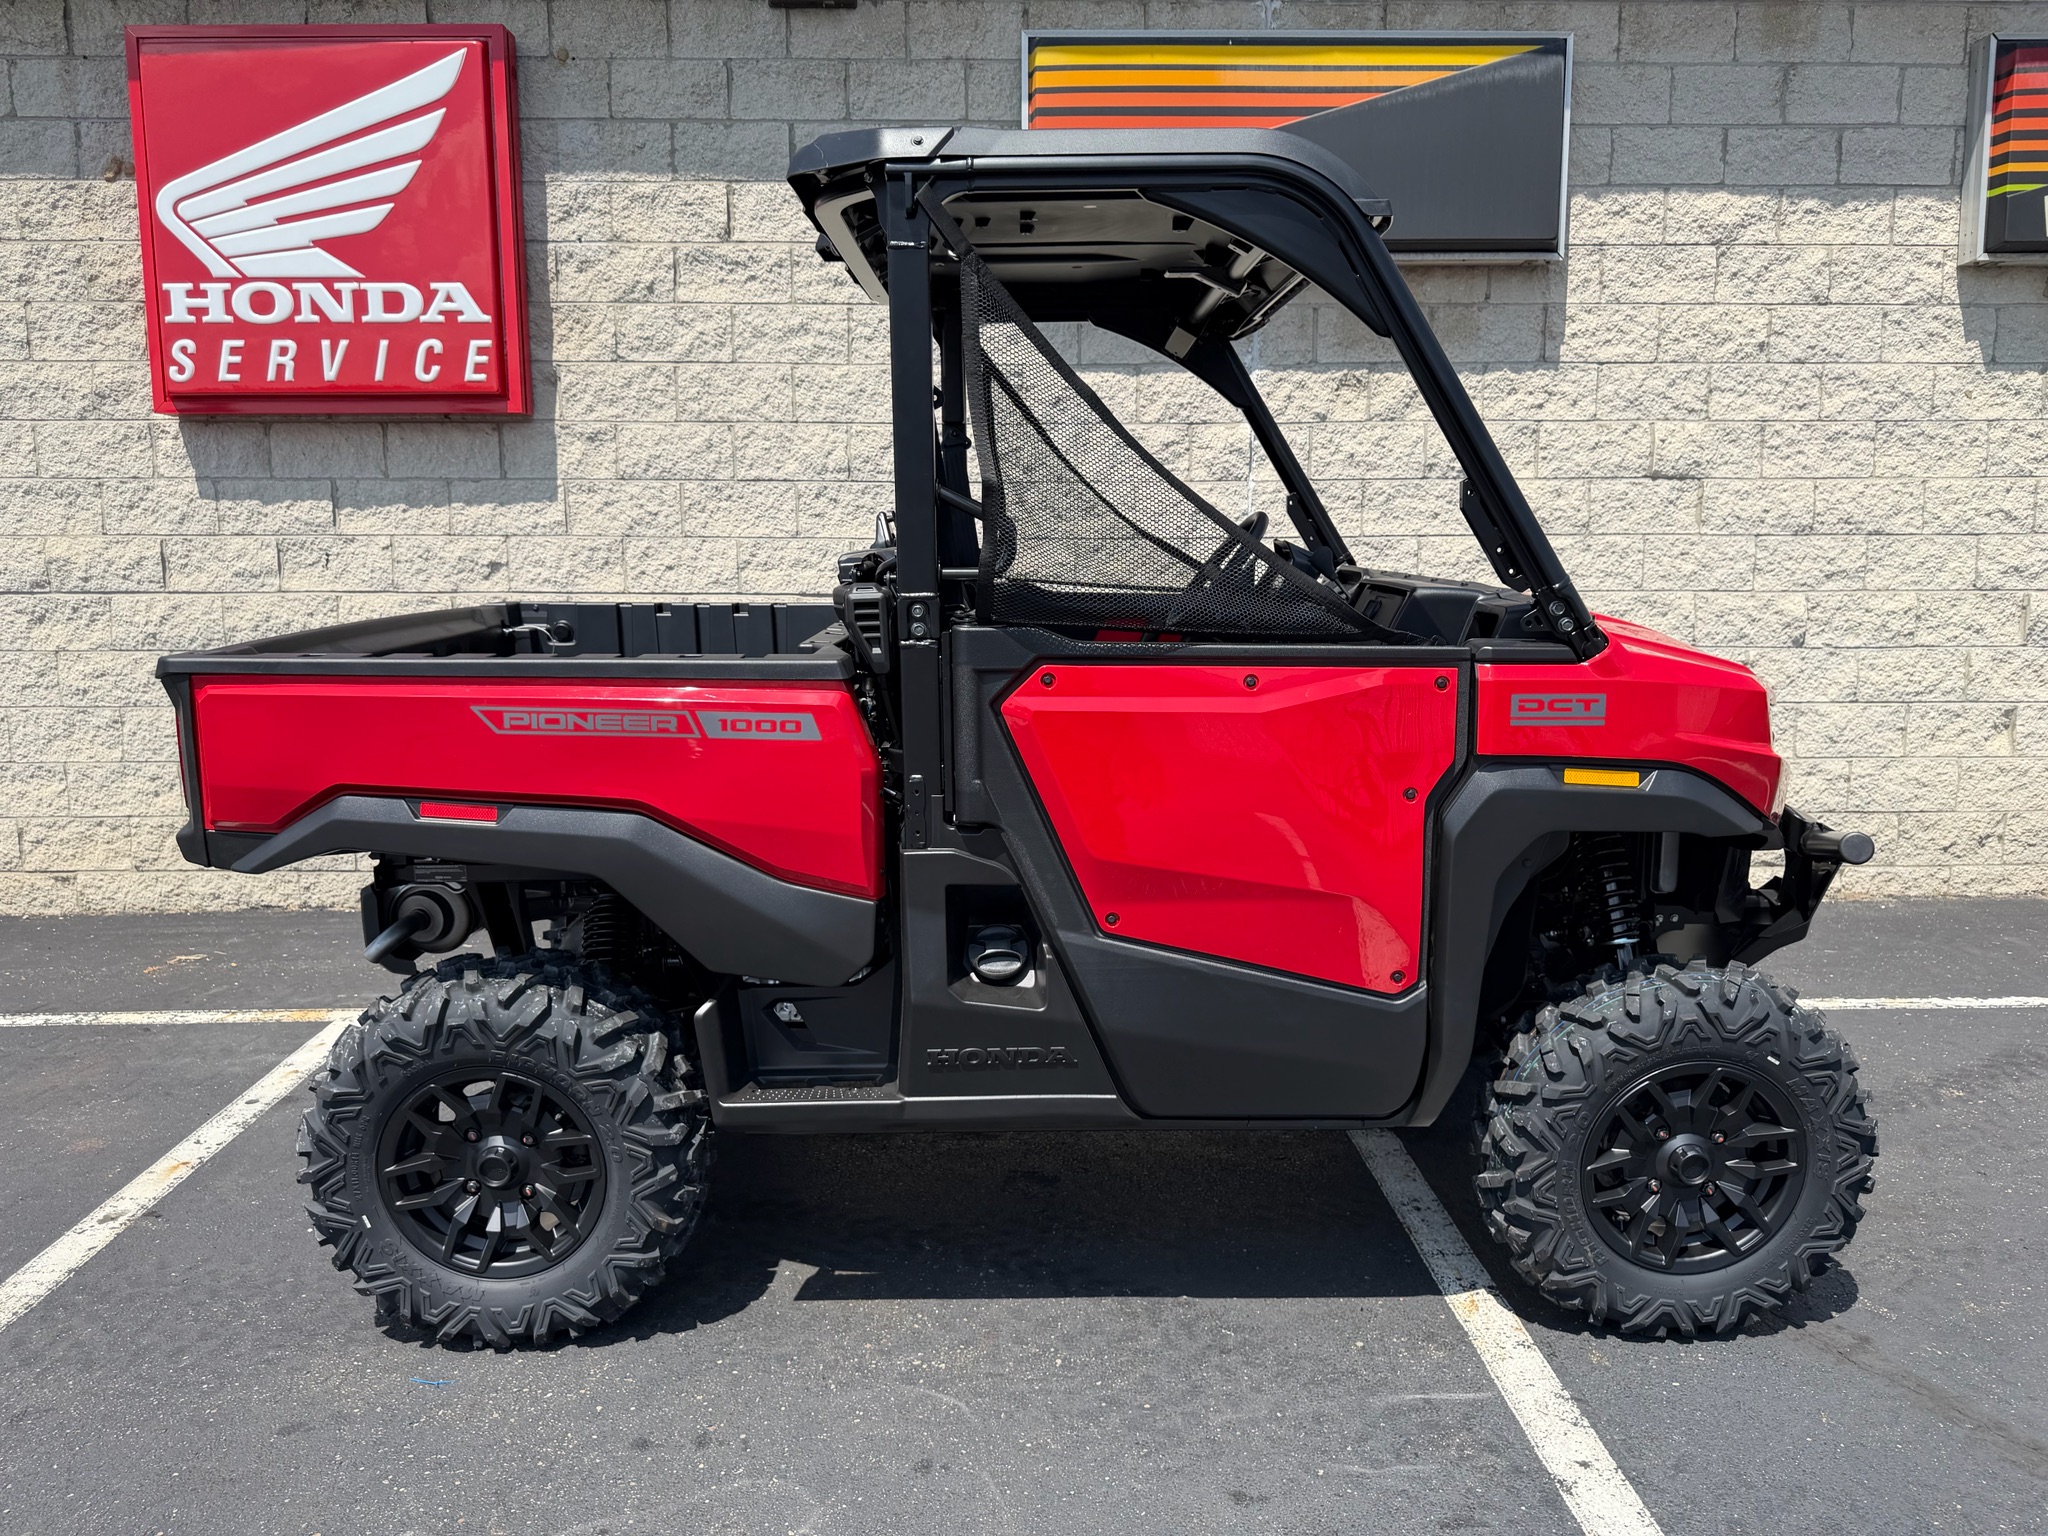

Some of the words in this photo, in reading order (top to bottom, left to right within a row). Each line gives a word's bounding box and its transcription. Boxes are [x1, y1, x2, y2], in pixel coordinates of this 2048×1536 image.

[162, 281, 493, 324] HONDA
[168, 338, 494, 383] SERVICE
[1518, 698, 1600, 713] DCT
[503, 712, 678, 733] PIONEER
[718, 718, 802, 733] 1000
[927, 1046, 1078, 1068] HONDA
[1786, 1077, 1832, 1180] MAXXIS
